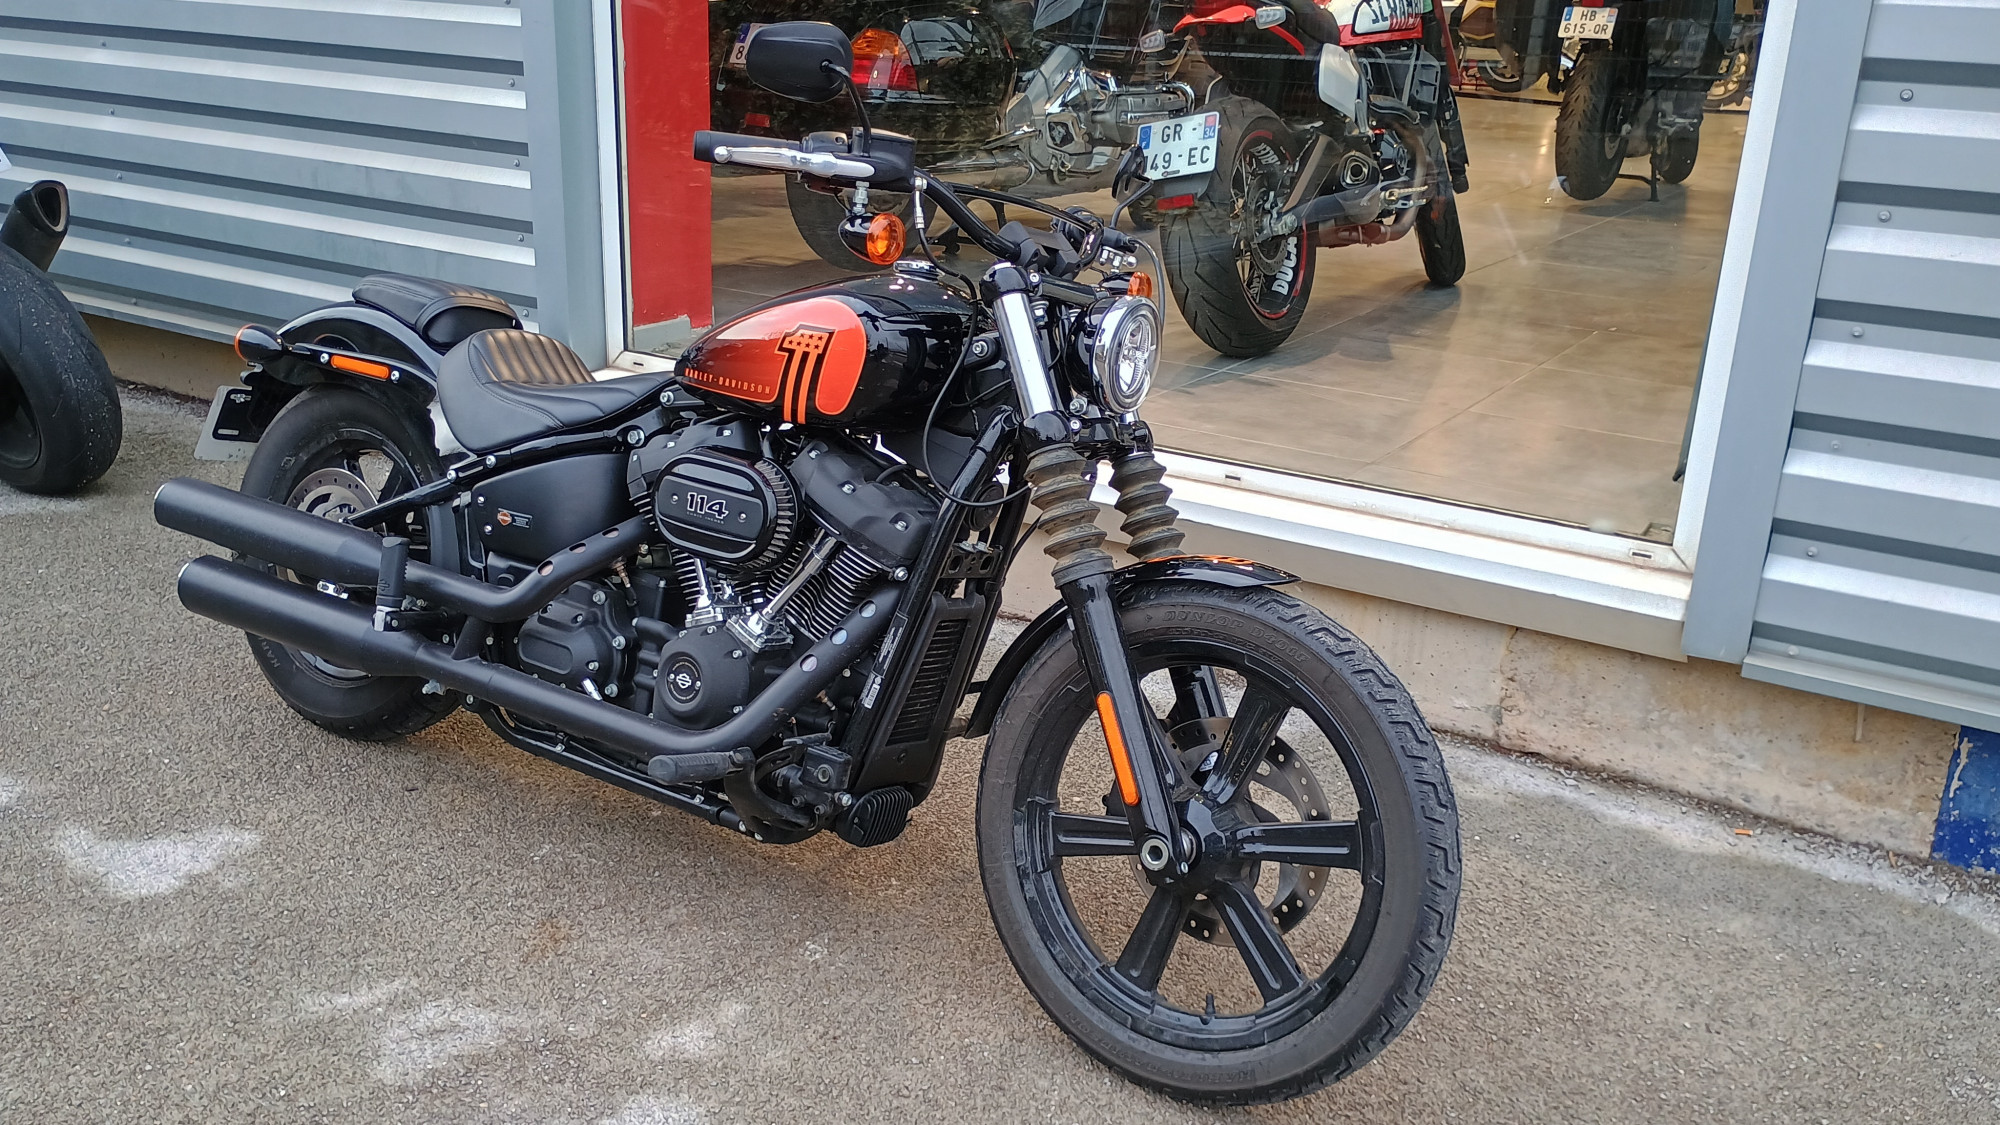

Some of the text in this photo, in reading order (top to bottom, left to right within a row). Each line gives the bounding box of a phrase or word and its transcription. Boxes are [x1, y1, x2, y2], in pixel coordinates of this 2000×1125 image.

[1580, 10, 1597, 21] HB
[735, 45, 747, 60] 8
[1161, 123, 1183, 143] GR
[1204, 127, 1215, 138] 34
[1271, 236, 1298, 296] DUCA
[684, 367, 772, 395] HARLEY-DAVIDSON
[687, 491, 729, 520] 114
